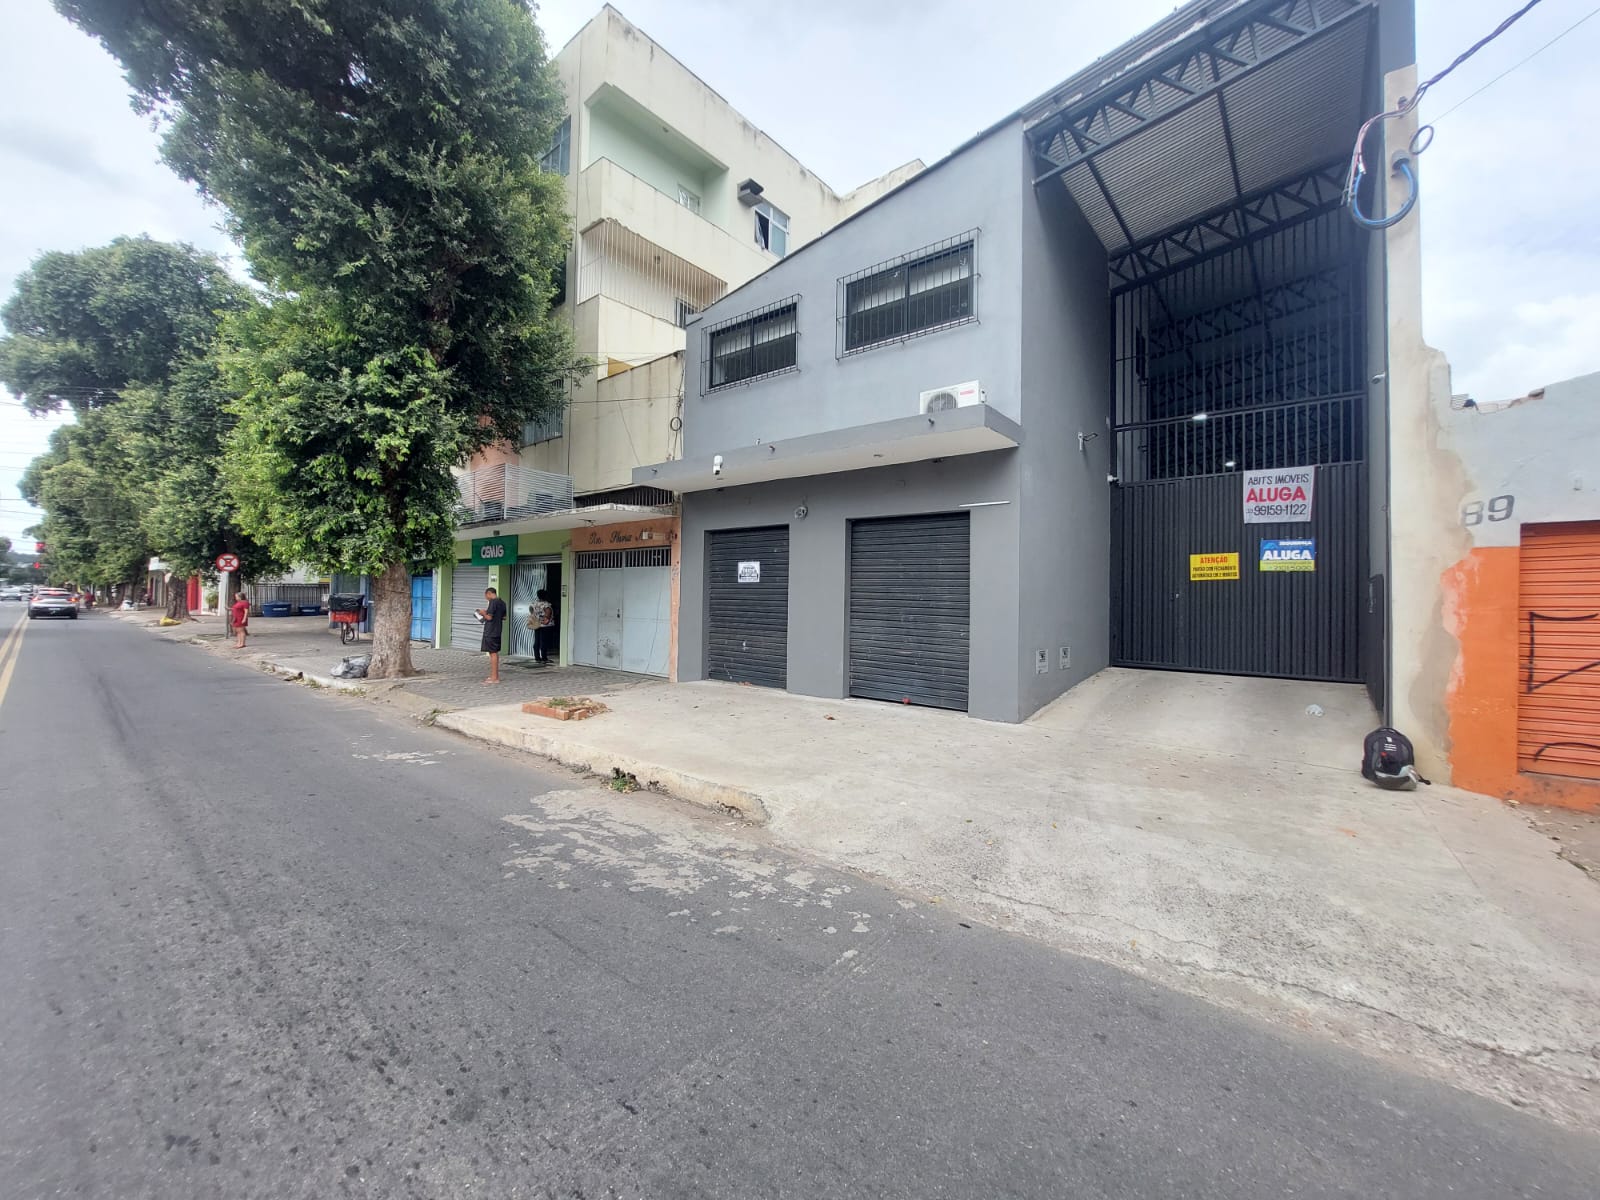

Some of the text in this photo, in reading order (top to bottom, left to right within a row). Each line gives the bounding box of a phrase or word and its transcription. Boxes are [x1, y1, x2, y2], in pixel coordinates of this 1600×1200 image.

[1246, 486, 1306, 503] ALUGA
[480, 545, 505, 559] CEMIG
[1262, 550, 1312, 560] ALUGA
